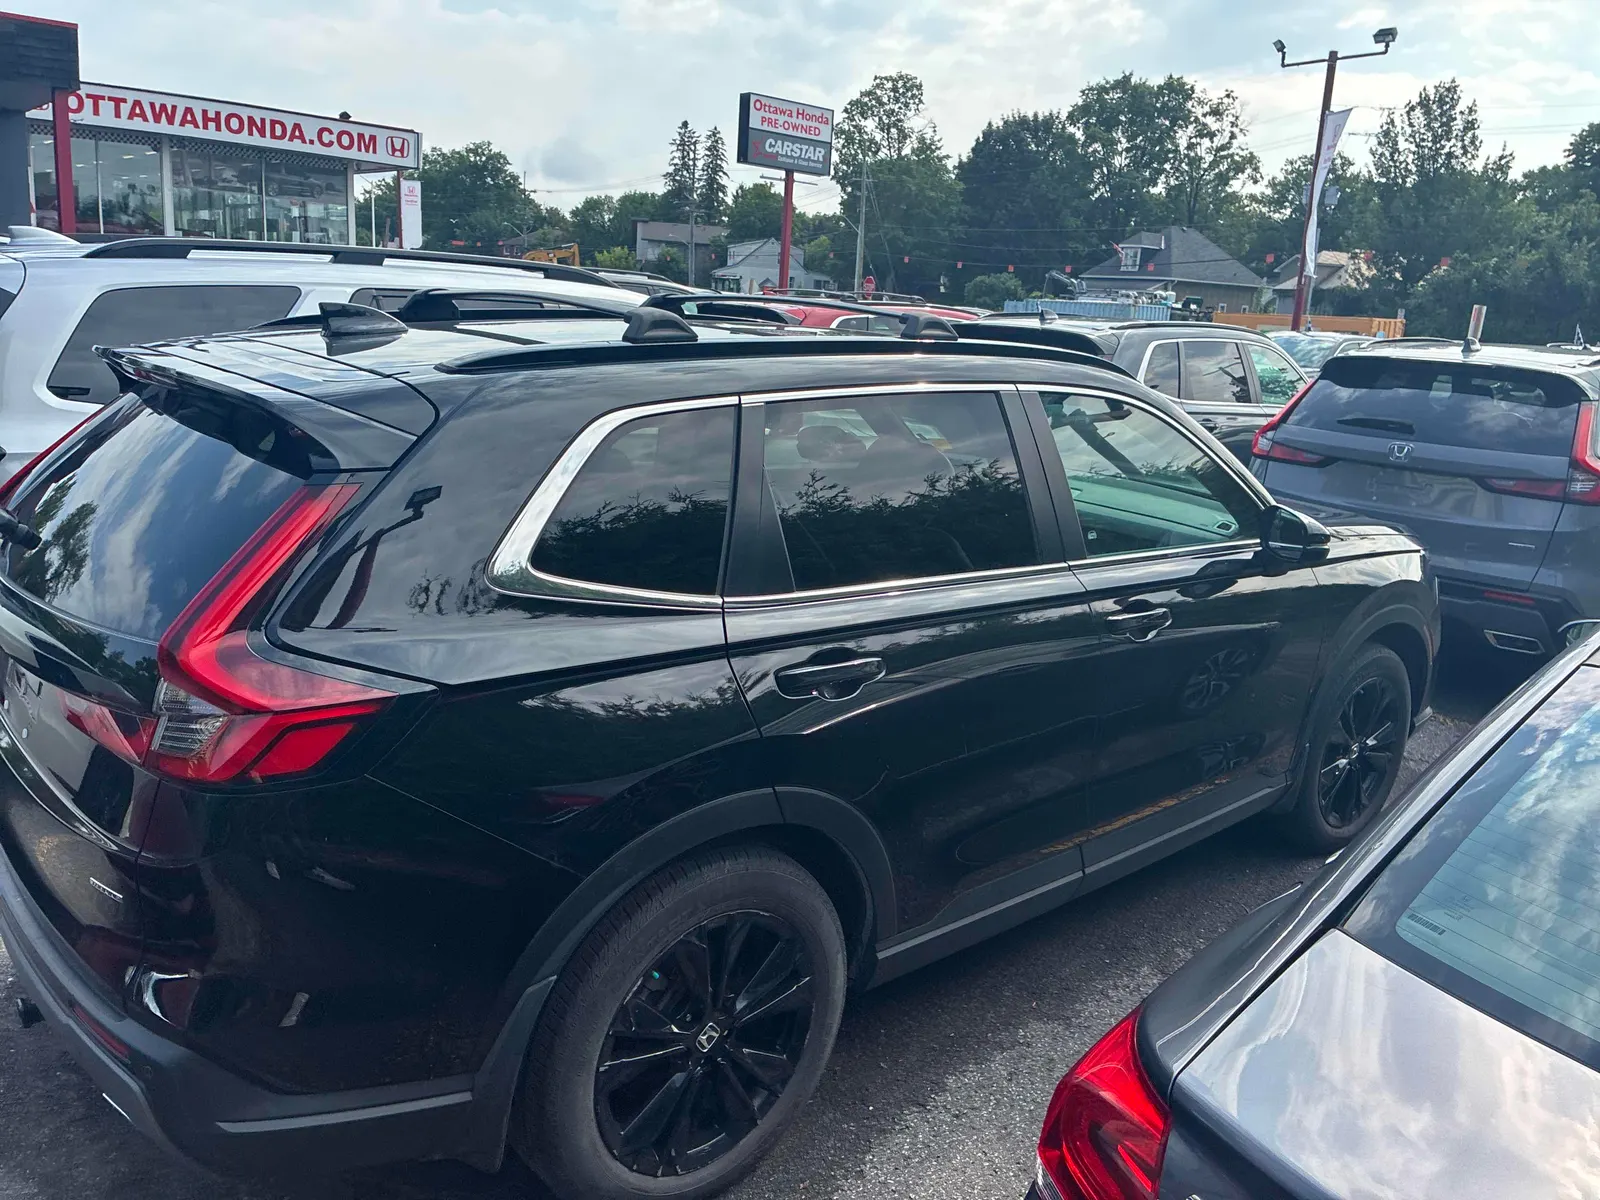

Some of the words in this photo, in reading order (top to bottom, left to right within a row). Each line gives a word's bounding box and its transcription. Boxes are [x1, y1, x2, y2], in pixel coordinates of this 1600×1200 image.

[67, 92, 378, 154] OTTAWAHONDA.COM
[753, 99, 793, 117] Ottawa
[797, 108, 829, 125] Honda
[761, 117, 821, 136] PRE-OWNED
[766, 138, 825, 161] CARSTAR
